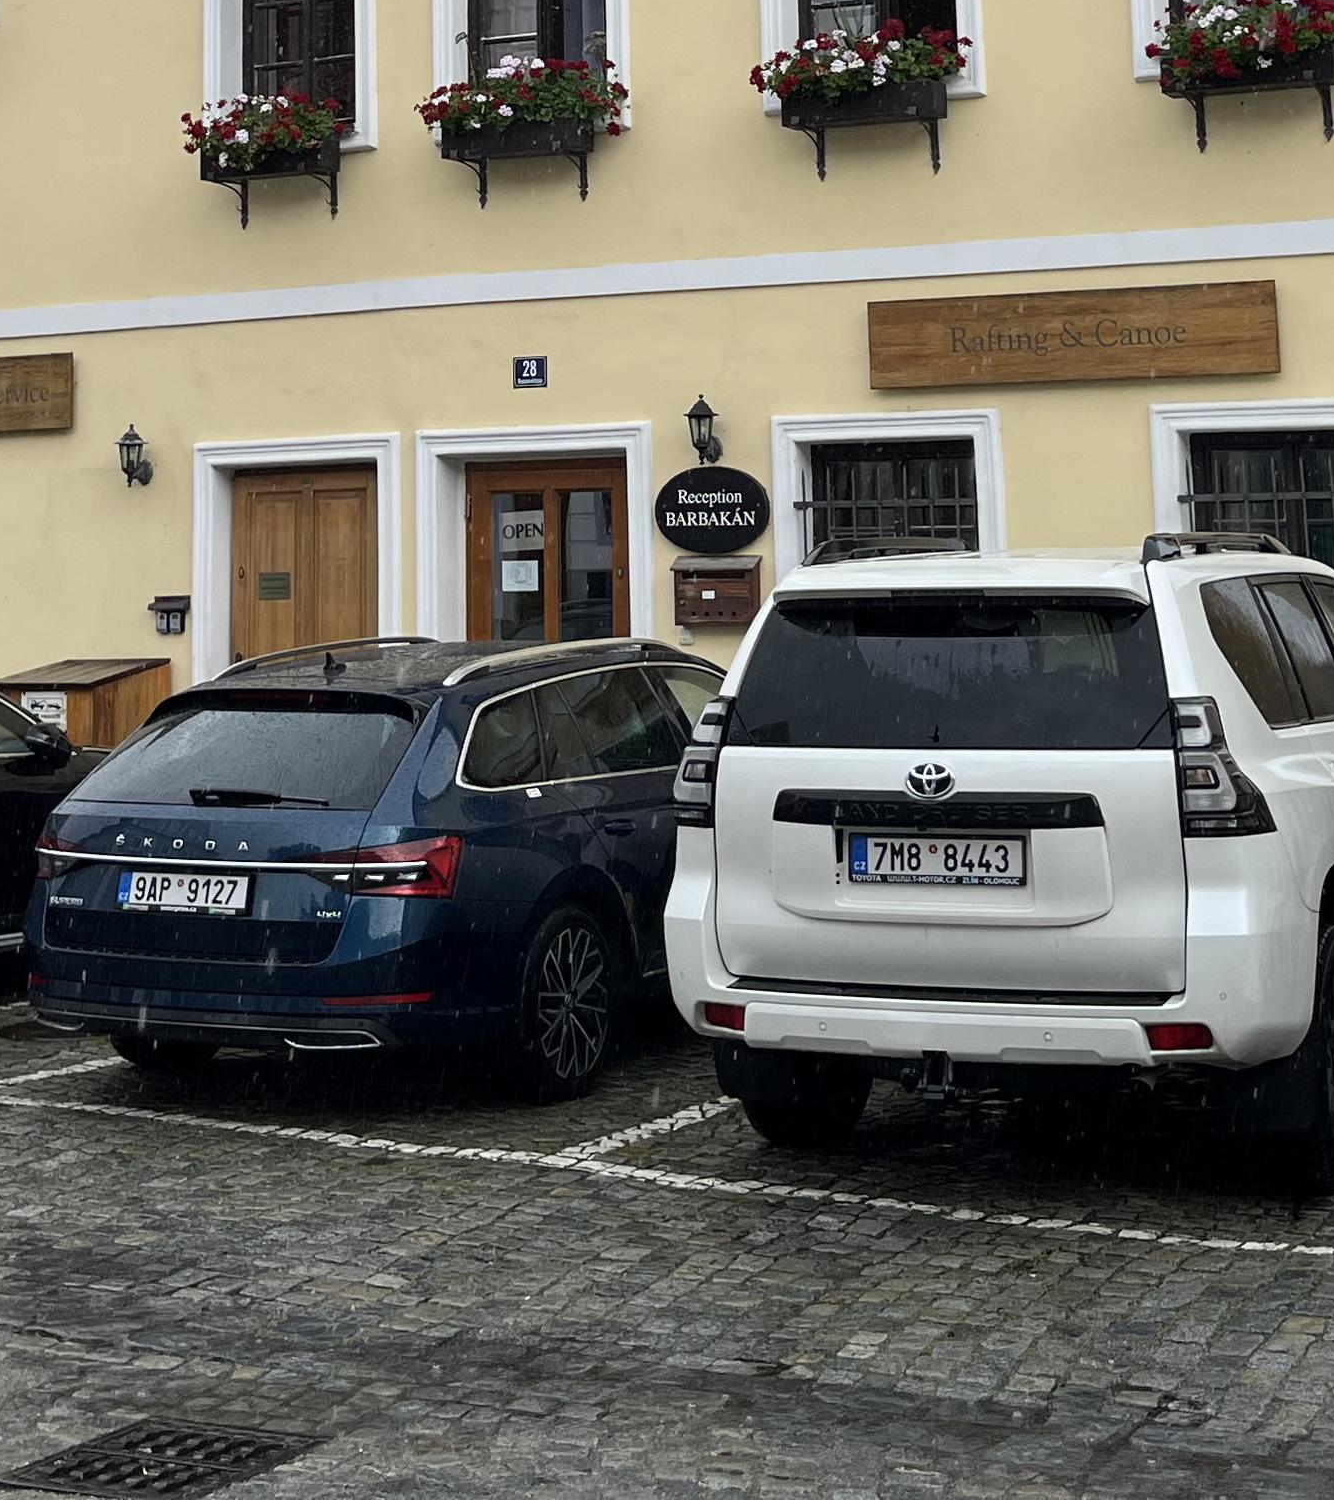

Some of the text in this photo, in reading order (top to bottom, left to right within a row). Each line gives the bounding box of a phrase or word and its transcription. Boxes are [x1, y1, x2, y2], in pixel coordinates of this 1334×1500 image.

[950, 318, 1188, 356] Rafting & Canoe
[522, 360, 537, 377] 28
[677, 489, 742, 507] Reception
[666, 507, 755, 527] BARBAKÁN
[503, 522, 544, 539] OPEN
[116, 834, 248, 850] ŠKODA
[854, 861, 866, 871] CZ
[874, 842, 1009, 873] 7M8 8443
[852, 874, 882, 882] TOYOTA
[983, 877, 1020, 886] OLOMOUC
[119, 891, 129, 901] CZ
[135, 876, 238, 905] 9AP 9127
